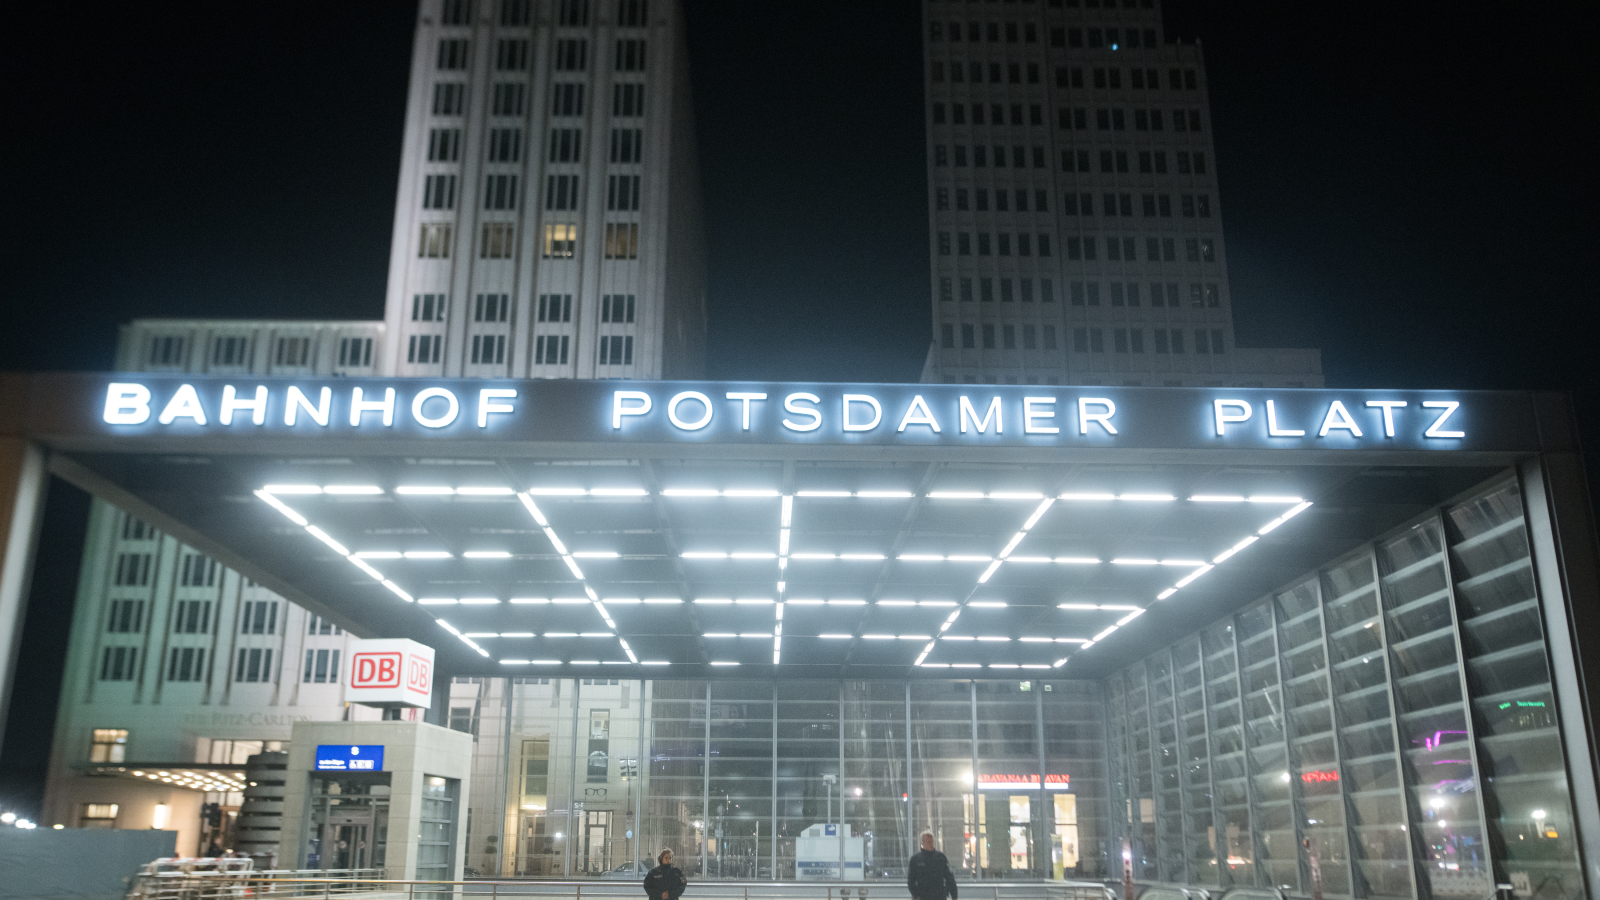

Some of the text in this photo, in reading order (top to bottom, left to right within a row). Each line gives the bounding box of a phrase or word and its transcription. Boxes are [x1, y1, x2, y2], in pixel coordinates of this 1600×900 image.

[102, 382, 1465, 439] BAHNHOF POTSDAMER PLATZ
[358, 658, 395, 683] DB
[410, 660, 428, 688] DB
